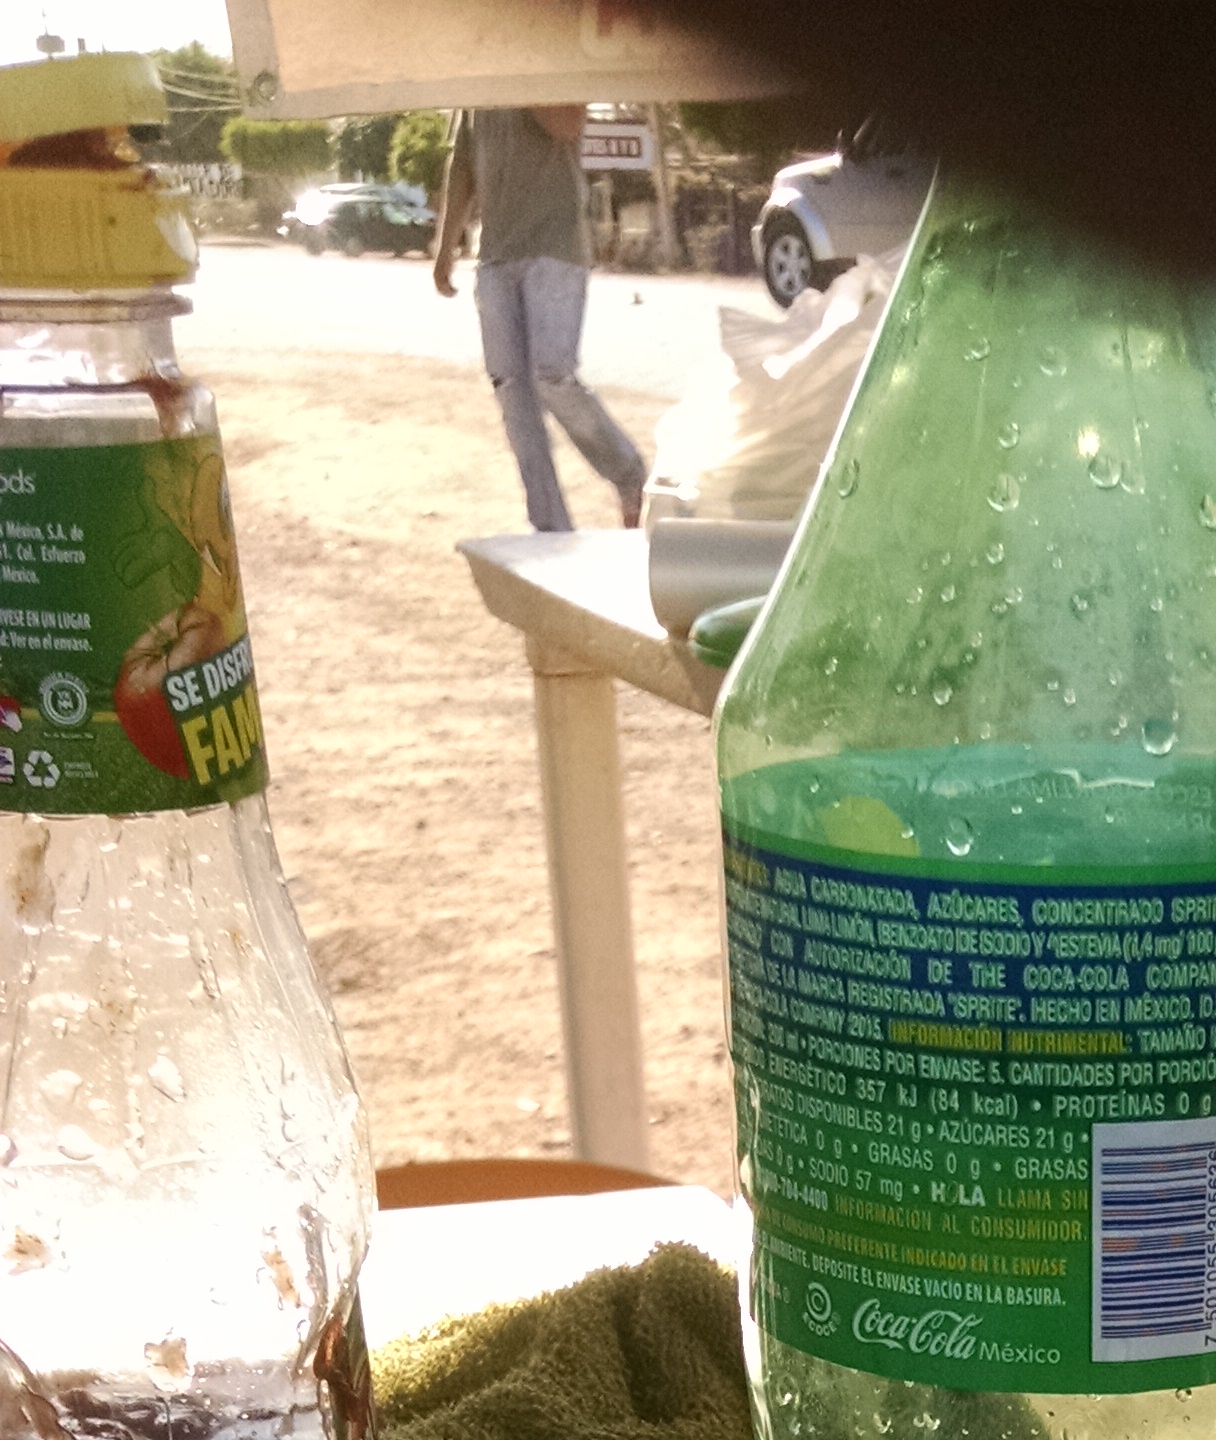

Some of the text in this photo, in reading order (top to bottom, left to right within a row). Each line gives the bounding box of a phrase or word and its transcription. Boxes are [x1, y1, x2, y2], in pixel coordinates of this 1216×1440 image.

[166, 670, 204, 712] SE
[926, 888, 1024, 928] AZÚCARES,
[1031, 897, 1165, 926] CONCENTRADO
[803, 938, 911, 981] AUTORIZACIÓN
[928, 957, 953, 985] DE
[969, 962, 1007, 989] THE
[1023, 964, 1130, 992] COCA-COLA
[979, 929, 1031, 957] SODIO
[797, 968, 846, 1003] MARCA
[847, 978, 945, 1017] REGISTRADA
[1030, 995, 1093, 1024] HECHO
[1095, 996, 1121, 1024] EN
[1124, 991, 1195, 1024] MÉXICO.
[807, 1034, 881, 1071] PORCIONES
[884, 1048, 915, 1076] POR
[918, 1054, 986, 1084] ENVASE:
[1009, 1061, 1115, 1087] CANTIDADES
[1119, 1062, 1153, 1086] POR
[888, 1017, 1003, 1052] INFORMACIÓN
[1005, 1029, 1133, 1053] NUTRIMENTAL:
[1137, 1022, 1207, 1051] TAMAÑO
[769, 1053, 1212, 1120] ENERGÉTICO 357 kJ (84 kcal) PROTEÍNAS 0 g
[797, 1094, 884, 1133] DISPONIBLES
[887, 1115, 904, 1136] 21
[911, 1123, 922, 1143] g
[938, 1117, 1030, 1146] AZÚCARES
[1035, 1127, 1056, 1149] 21
[1063, 1132, 1074, 1153] g
[815, 1129, 826, 1151] 0
[834, 1138, 843, 1160] g
[868, 1142, 934, 1171] GRASAS
[946, 1152, 957, 1175] 0
[970, 1158, 981, 1180] g
[1014, 1157, 1089, 1180] GRASAS
[808, 1157, 850, 1188] SODIO
[855, 1170, 873, 1192] 57
[880, 1178, 904, 1203] mg
[998, 1187, 1051, 1210] LLAMA
[1061, 1189, 1088, 1211] SIN
[941, 1216, 961, 1234] AL
[970, 1214, 1088, 1242] CONSUMIDOR.
[812, 1254, 860, 1283] DEPOSITE
[861, 1267, 874, 1287] EL
[876, 1271, 922, 1296] ENVASE
[965, 1283, 983, 1302] EN
[986, 1285, 1002, 1304] LA
[1005, 1286, 1066, 1307] BASURA.
[901, 1248, 966, 1272] INDICADO
[970, 1252, 988, 1273] EN
[992, 1254, 1008, 1273] EL
[1012, 1256, 1067, 1277] ENVASE
[852, 1298, 1061, 1364] Coca-Cola México
